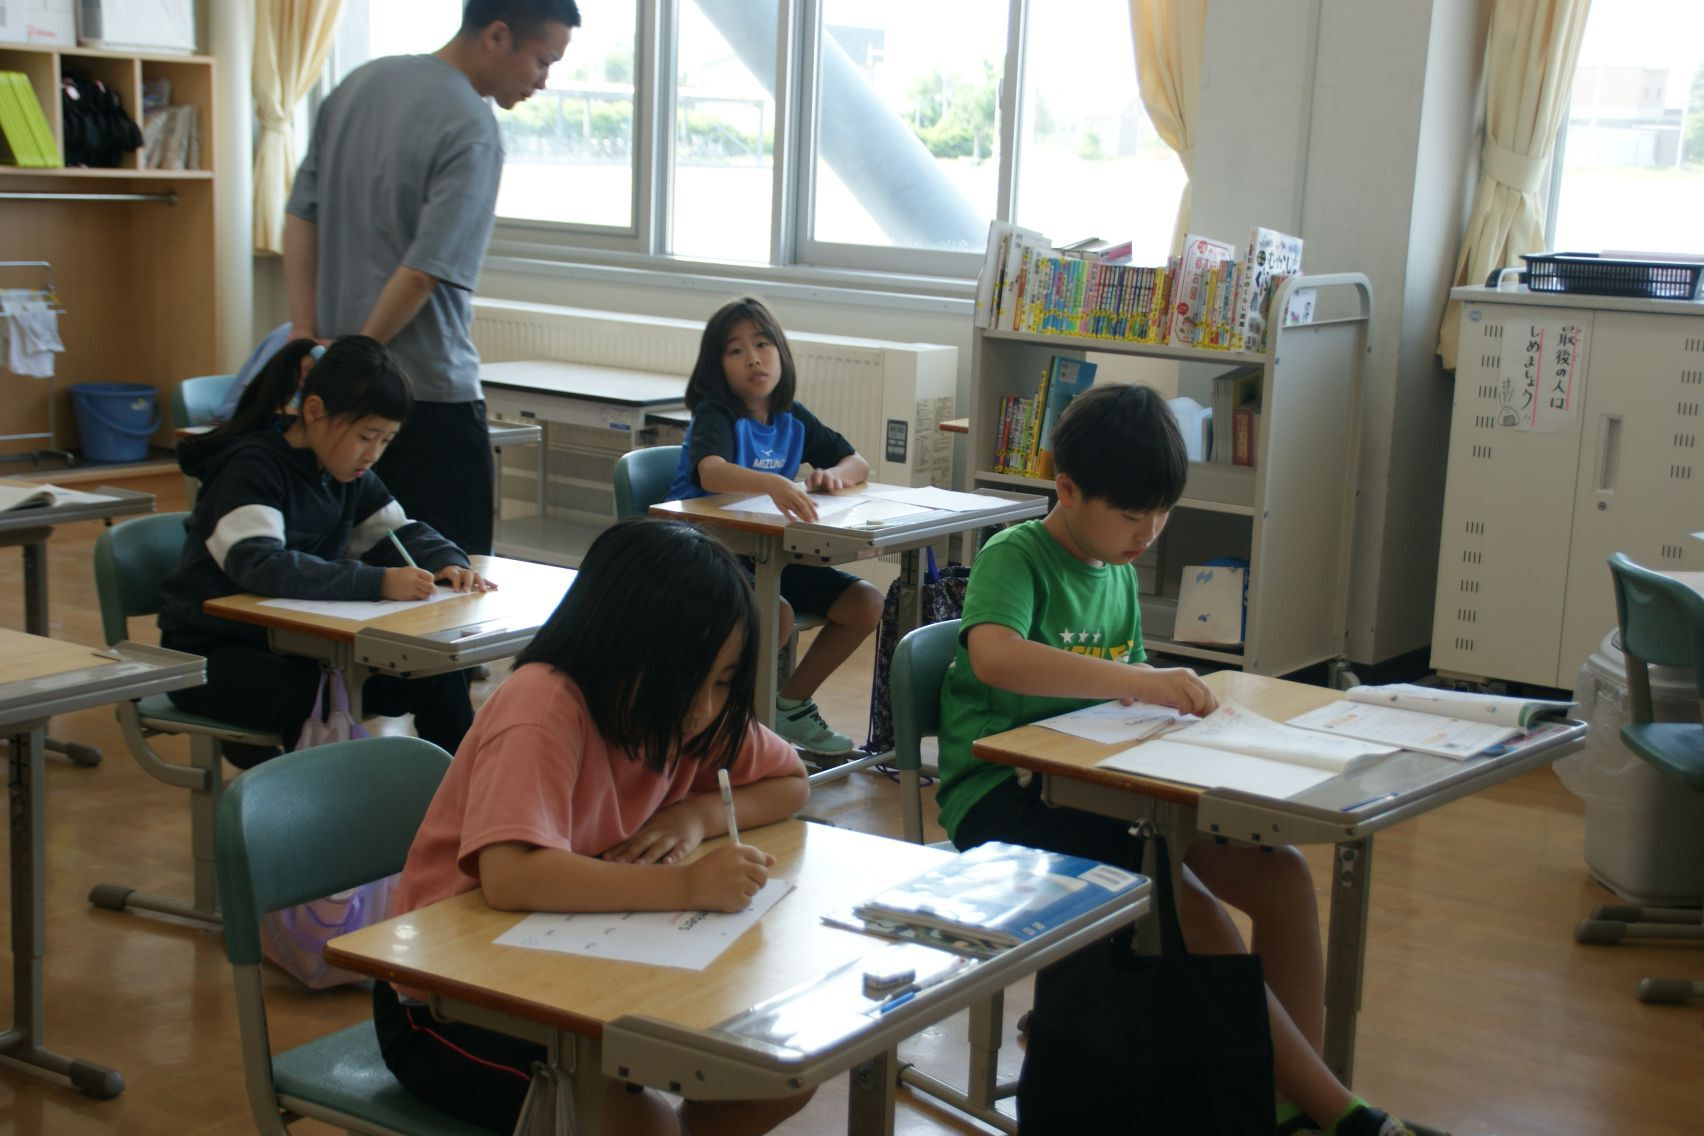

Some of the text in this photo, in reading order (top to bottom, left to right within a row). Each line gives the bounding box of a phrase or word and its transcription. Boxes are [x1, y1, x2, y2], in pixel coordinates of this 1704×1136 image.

[1520, 324, 1541, 411] しめましょう
[1550, 324, 1577, 410] 最後の人は
